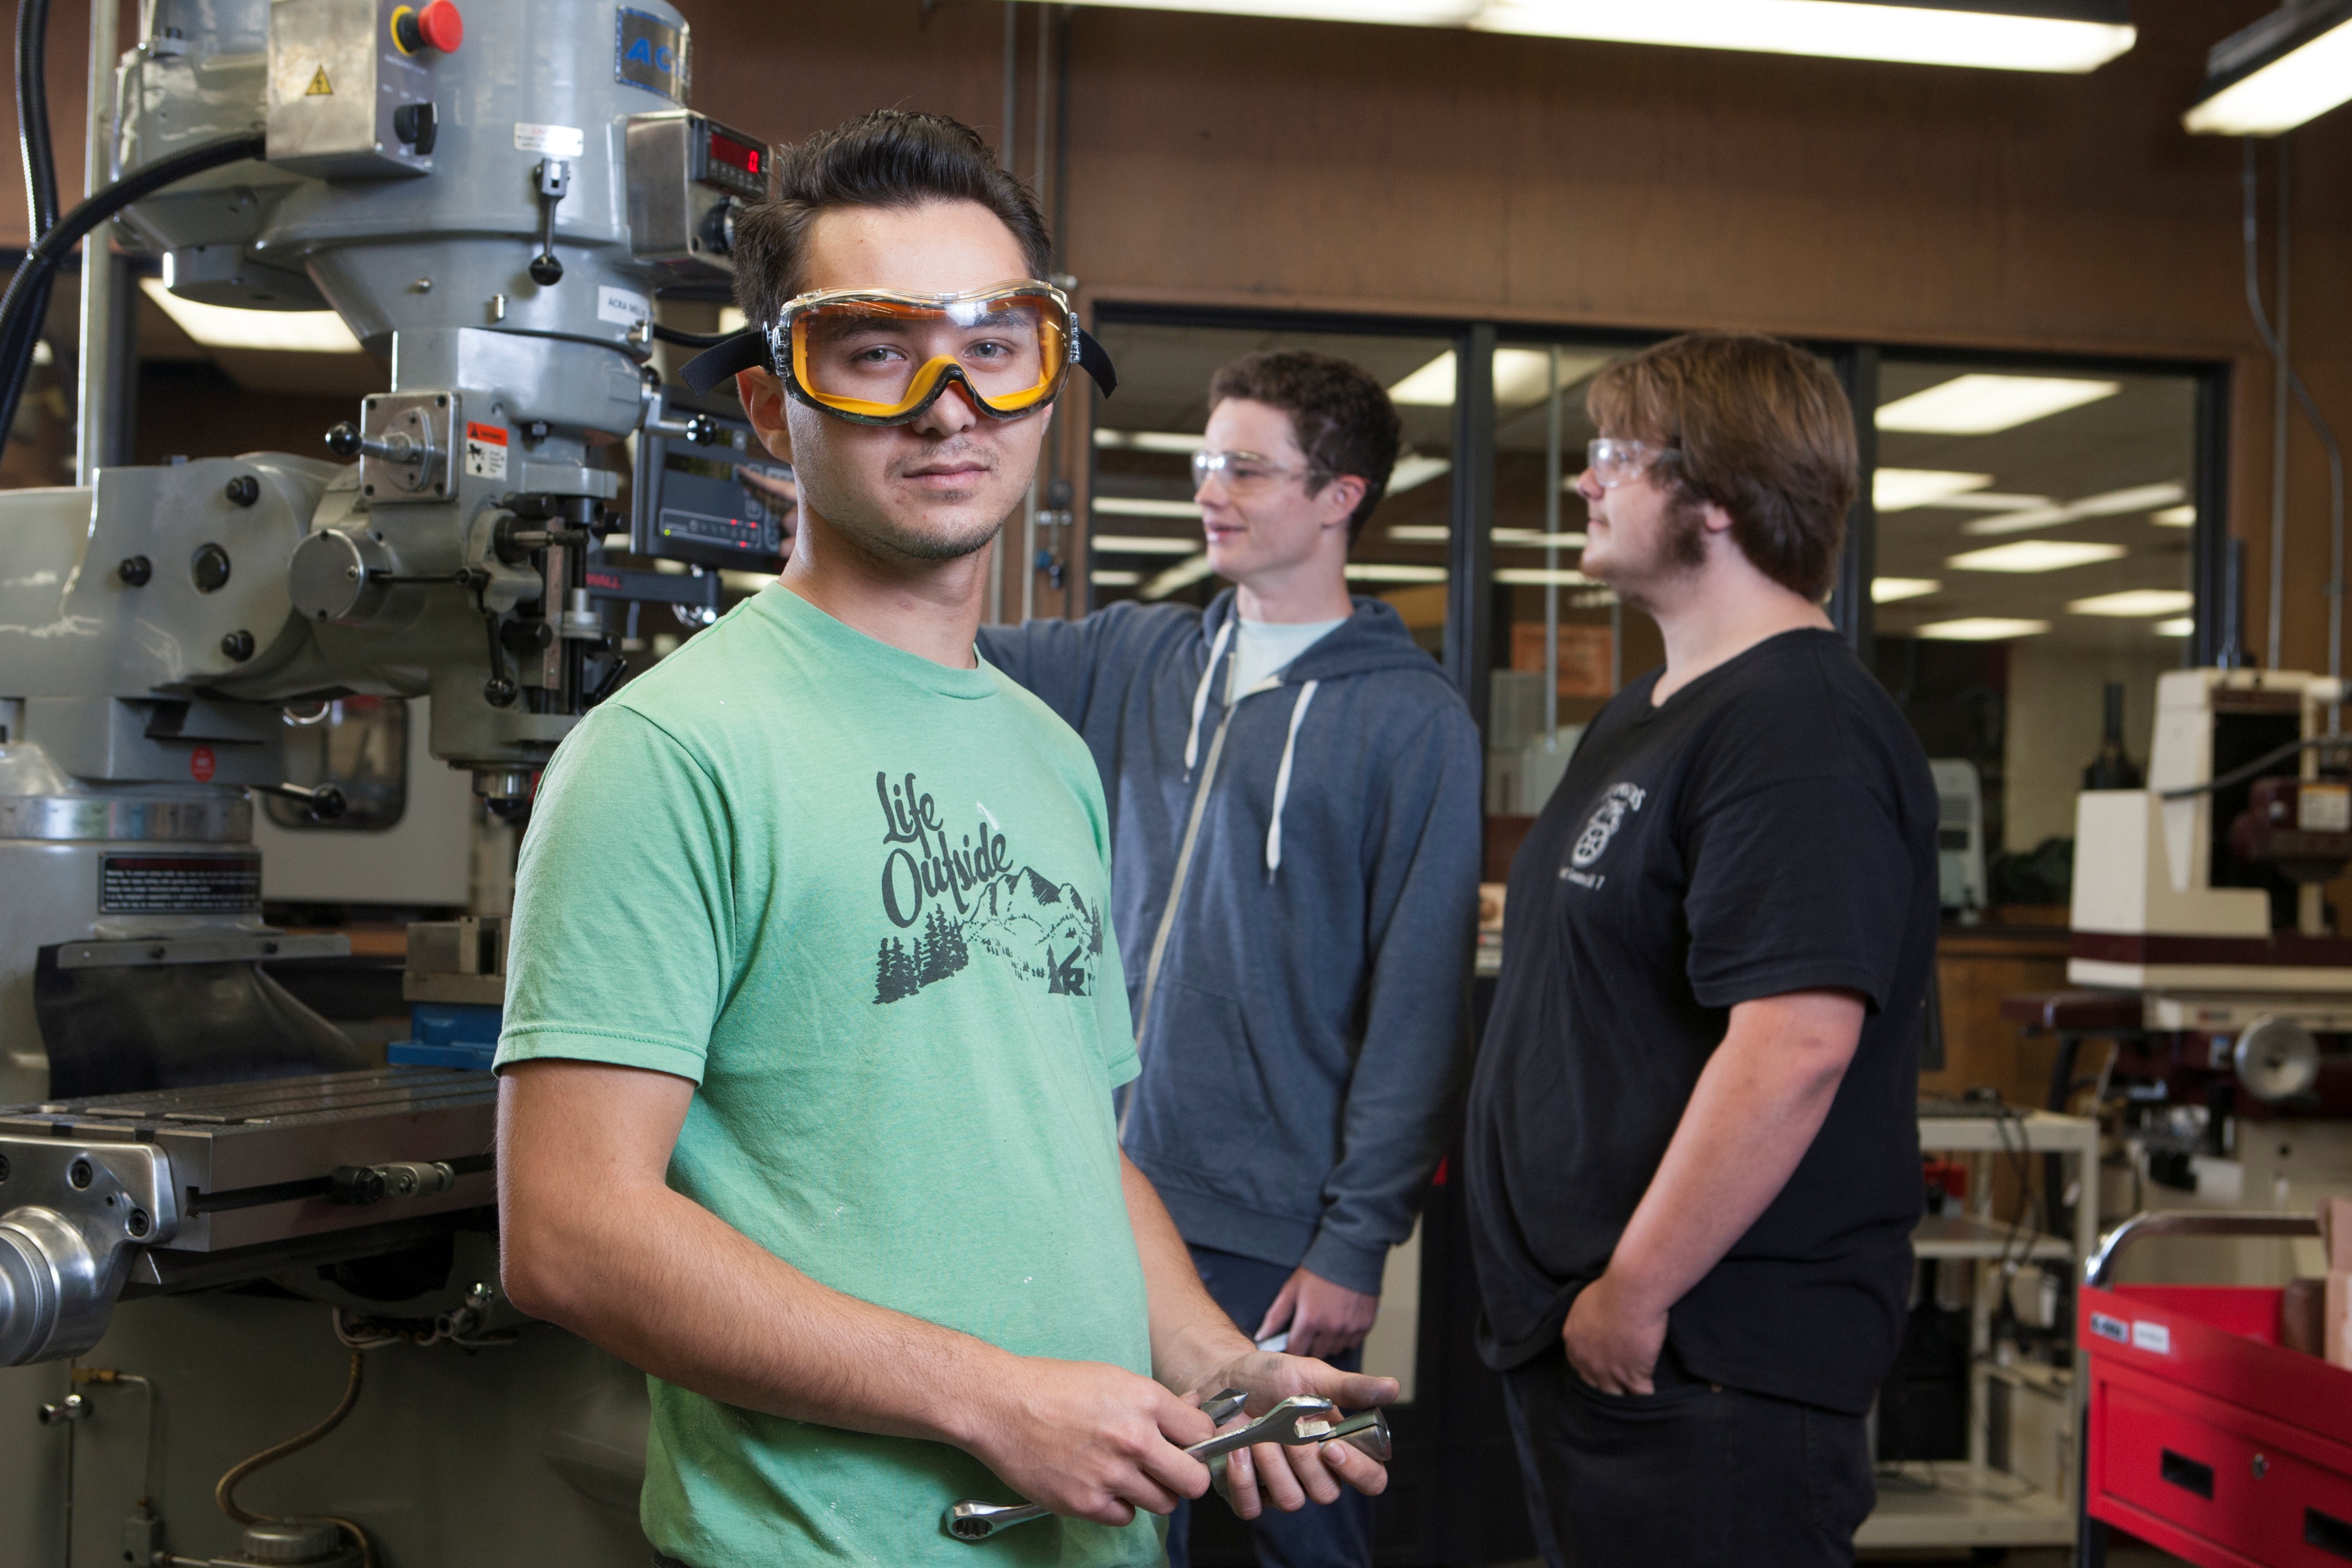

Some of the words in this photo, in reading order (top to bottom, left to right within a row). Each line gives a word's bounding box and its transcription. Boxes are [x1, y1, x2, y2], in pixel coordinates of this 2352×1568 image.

[585, 573, 622, 590] WALL
[876, 771, 944, 859] Life
[881, 821, 1014, 928] Outside
